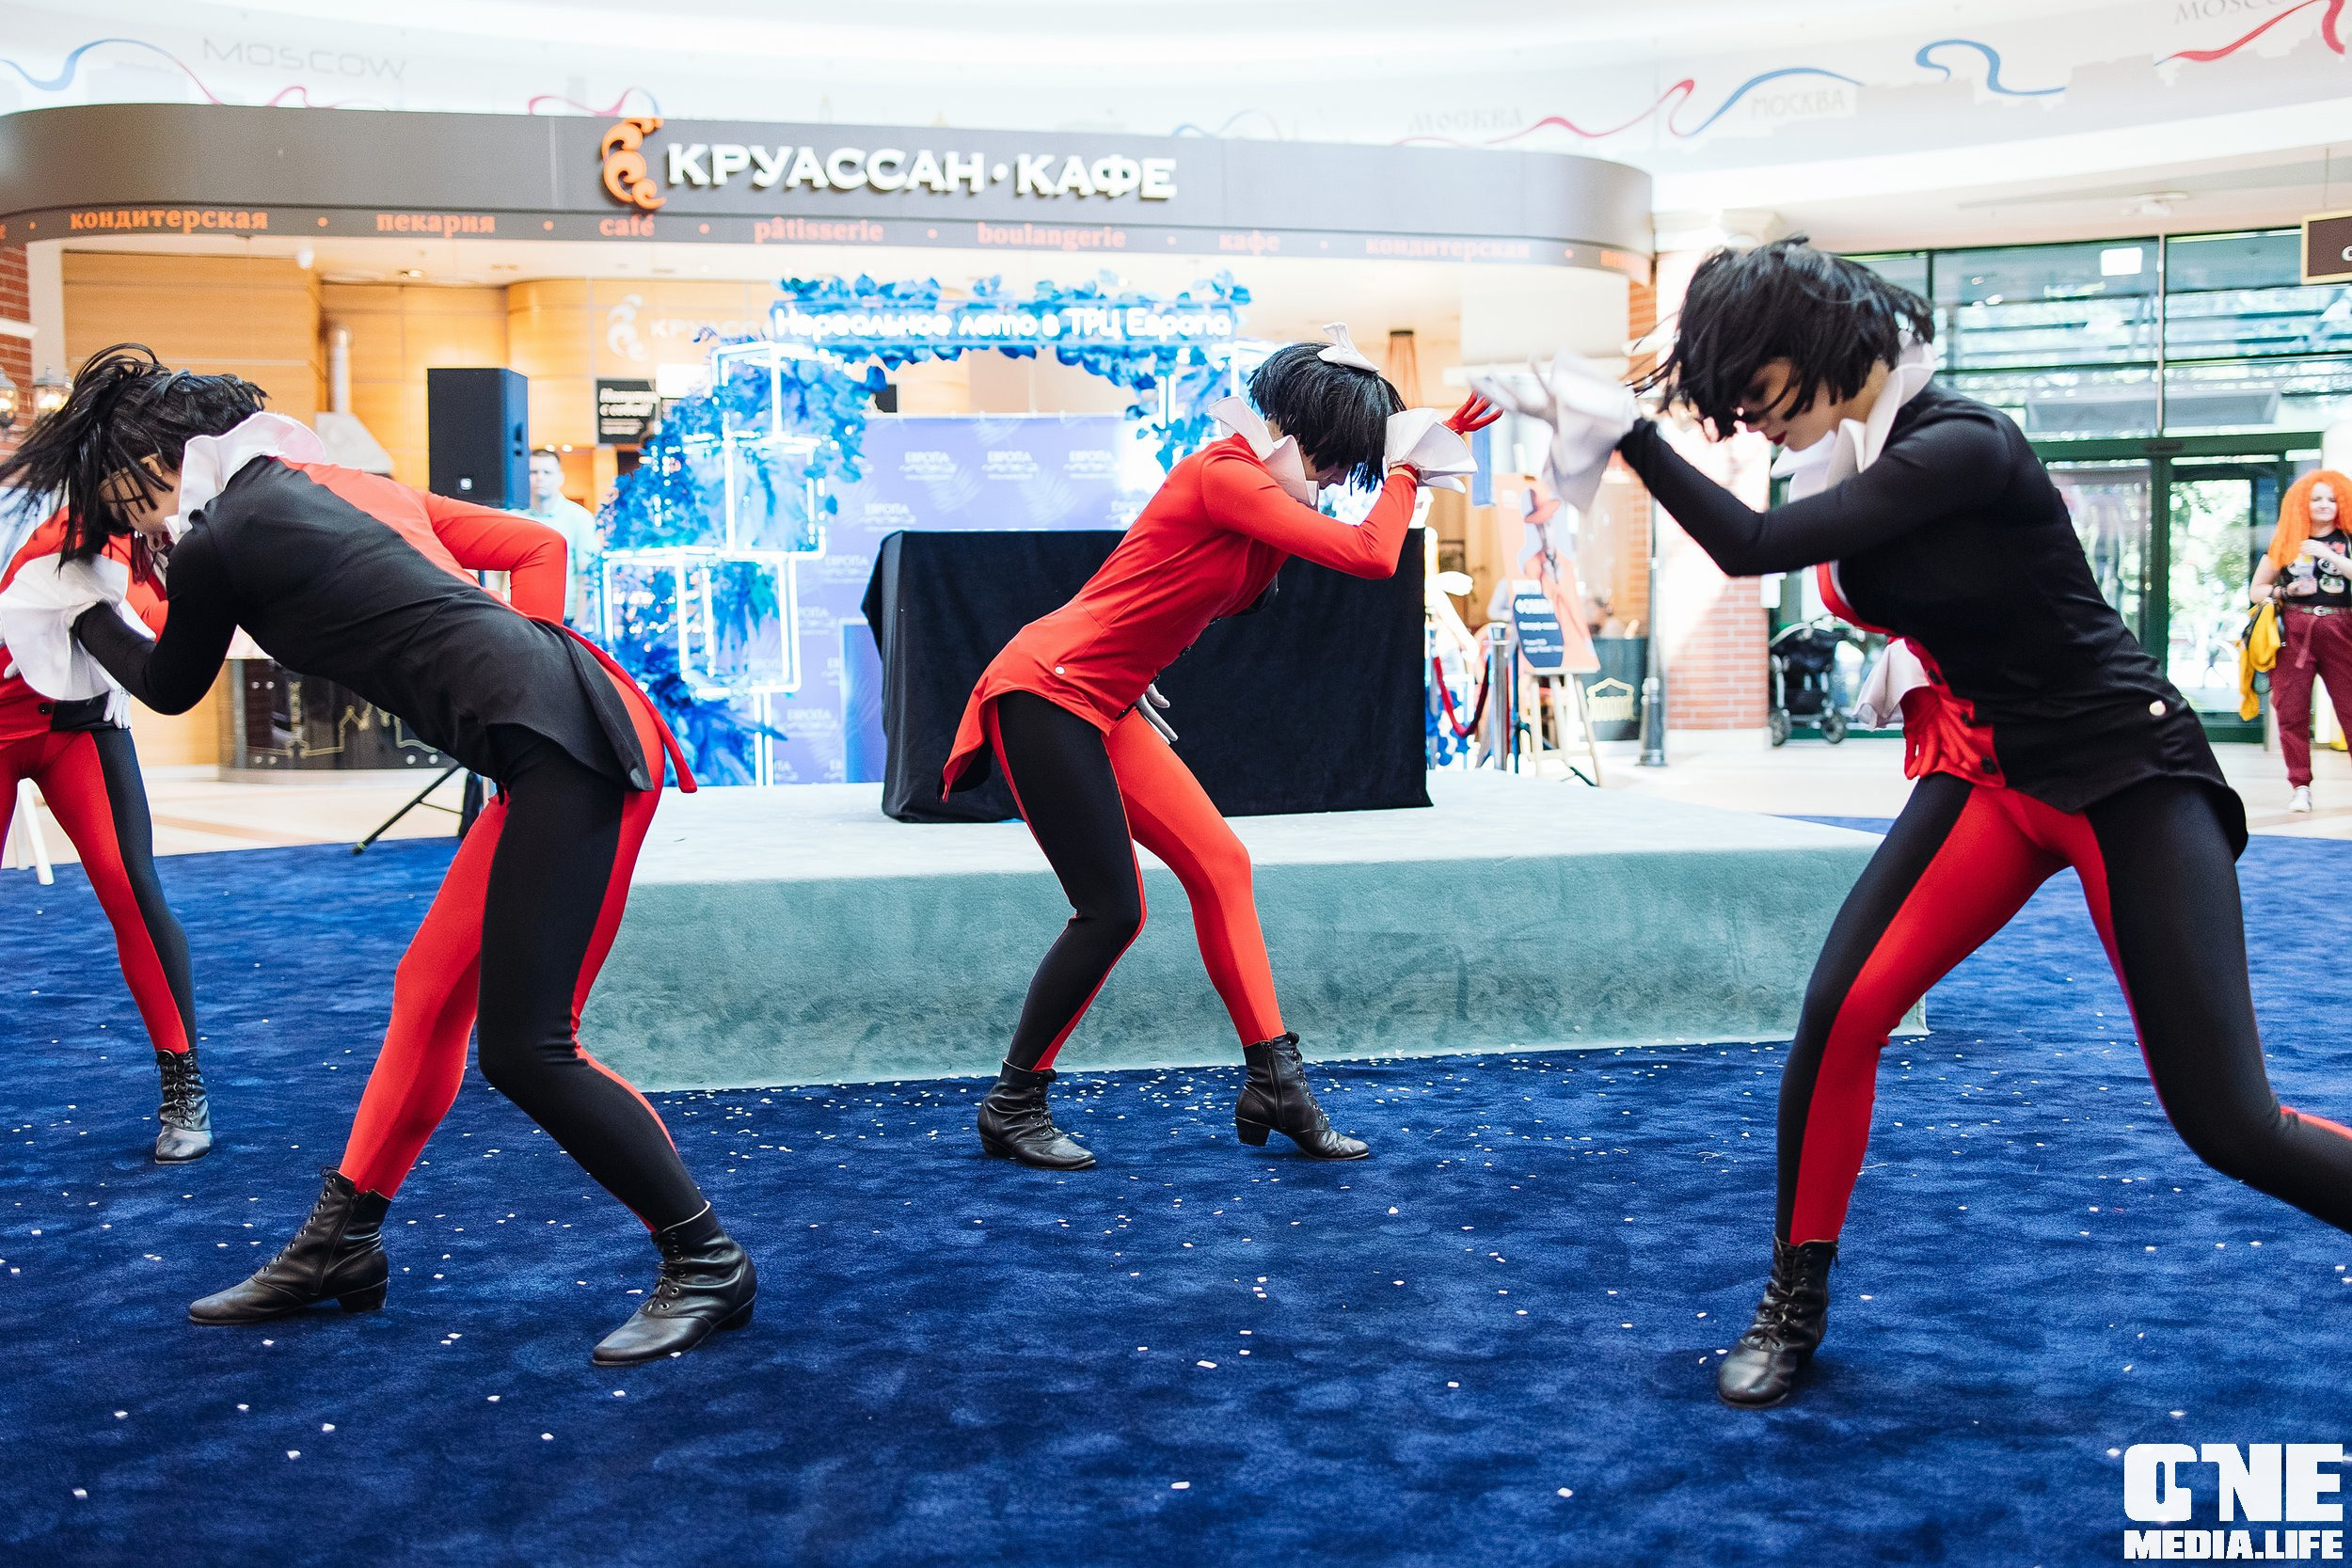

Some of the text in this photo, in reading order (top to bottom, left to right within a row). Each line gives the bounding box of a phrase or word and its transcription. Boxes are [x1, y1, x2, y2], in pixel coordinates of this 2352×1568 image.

[200, 37, 406, 80] MOSCOW
[1751, 87, 1847, 119] МОСКВА
[1407, 106, 1524, 134] МОСКВА
[667, 143, 1178, 198] КРУАССАН КАФЕ
[70, 209, 268, 235] кондитерская
[376, 213, 496, 239] пекарня
[598, 214, 656, 237] café
[753, 216, 884, 245] pâtisserie
[977, 222, 1127, 252] boulangerie
[649, 318, 773, 340] КРУАСС
[775, 308, 1232, 342] Нереальное лето в ТРЦ Европа
